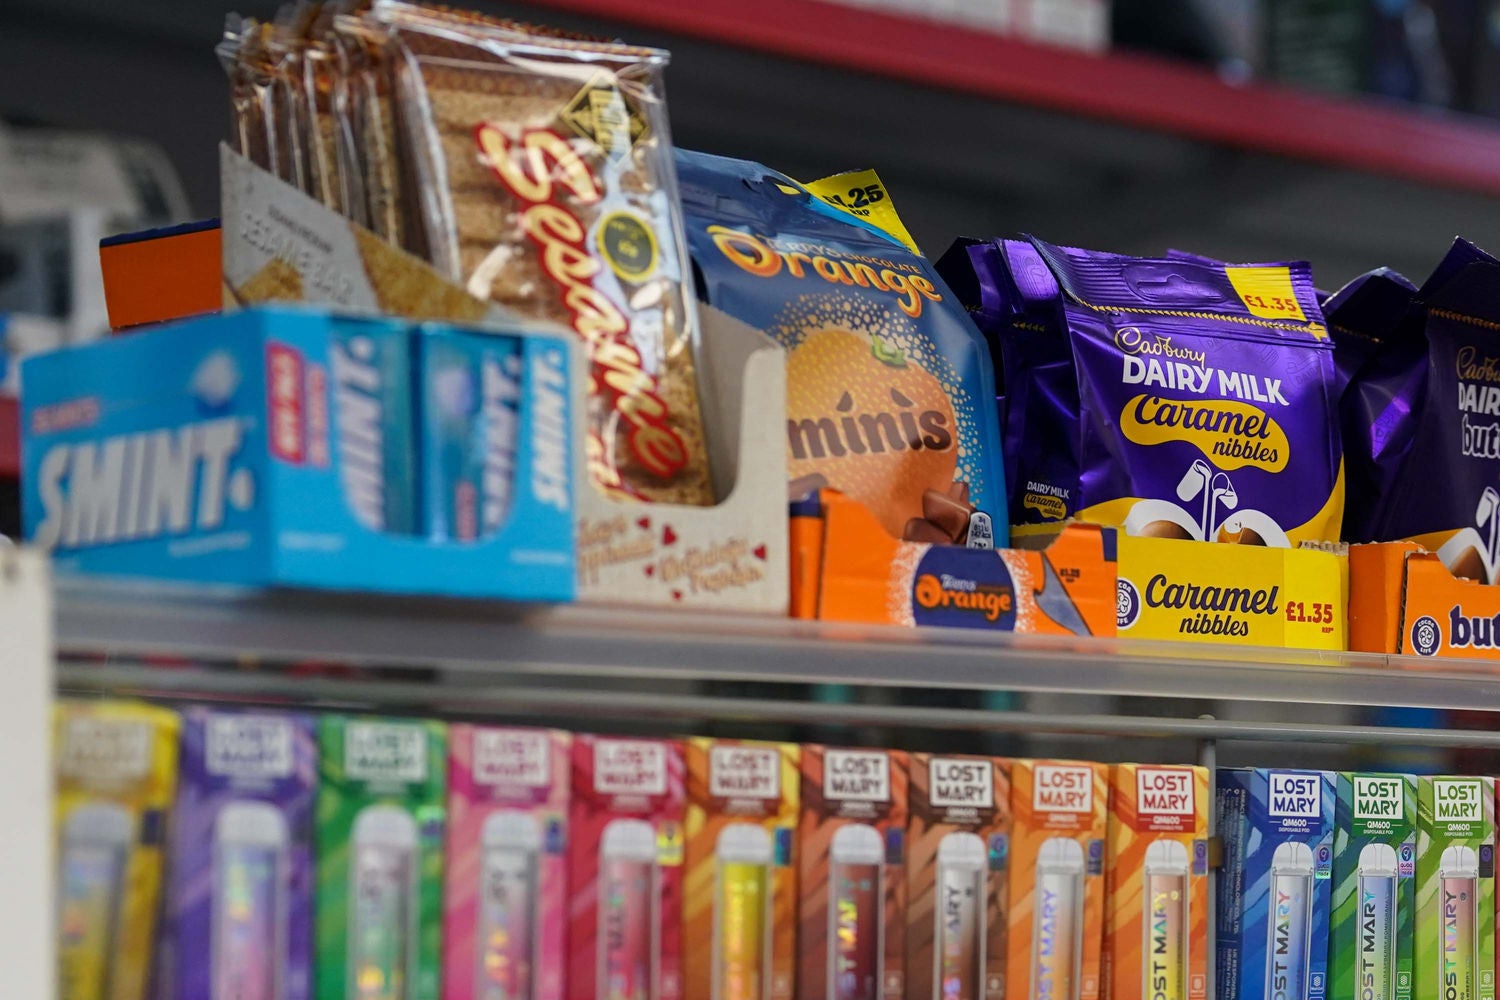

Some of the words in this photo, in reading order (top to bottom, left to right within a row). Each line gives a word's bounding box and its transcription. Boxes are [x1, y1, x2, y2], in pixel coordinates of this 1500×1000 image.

[706, 224, 943, 318] Orange
[1244, 294, 1298, 312] £1.35
[1113, 326, 1207, 371] Cadbury
[1121, 354, 1215, 394] DAIRY
[1217, 368, 1291, 406] MILK
[788, 388, 954, 460] minis
[1133, 393, 1272, 440] Caramel
[1211, 438, 1279, 464] nibbles
[1048, 485, 1071, 500] MILK
[914, 573, 1012, 622] Orange
[1145, 573, 1280, 616] Caramel
[1285, 600, 1334, 624] £1.35
[1178, 612, 1250, 637] nibbles
[936, 766, 986, 783] LOST
[1039, 772, 1088, 788] LOST
[1142, 774, 1188, 792] LOST
[1274, 778, 1316, 795] LOST
[1358, 781, 1399, 798] LOST
[1438, 784, 1477, 801] LOST
[1039, 791, 1088, 807] MARY
[1143, 793, 1189, 811] MARY
[1273, 797, 1316, 813] MARY
[1358, 800, 1400, 816] MARY
[1438, 802, 1478, 818] MARY
[1363, 888, 1376, 953] MARY
[1445, 890, 1457, 952] MARY
